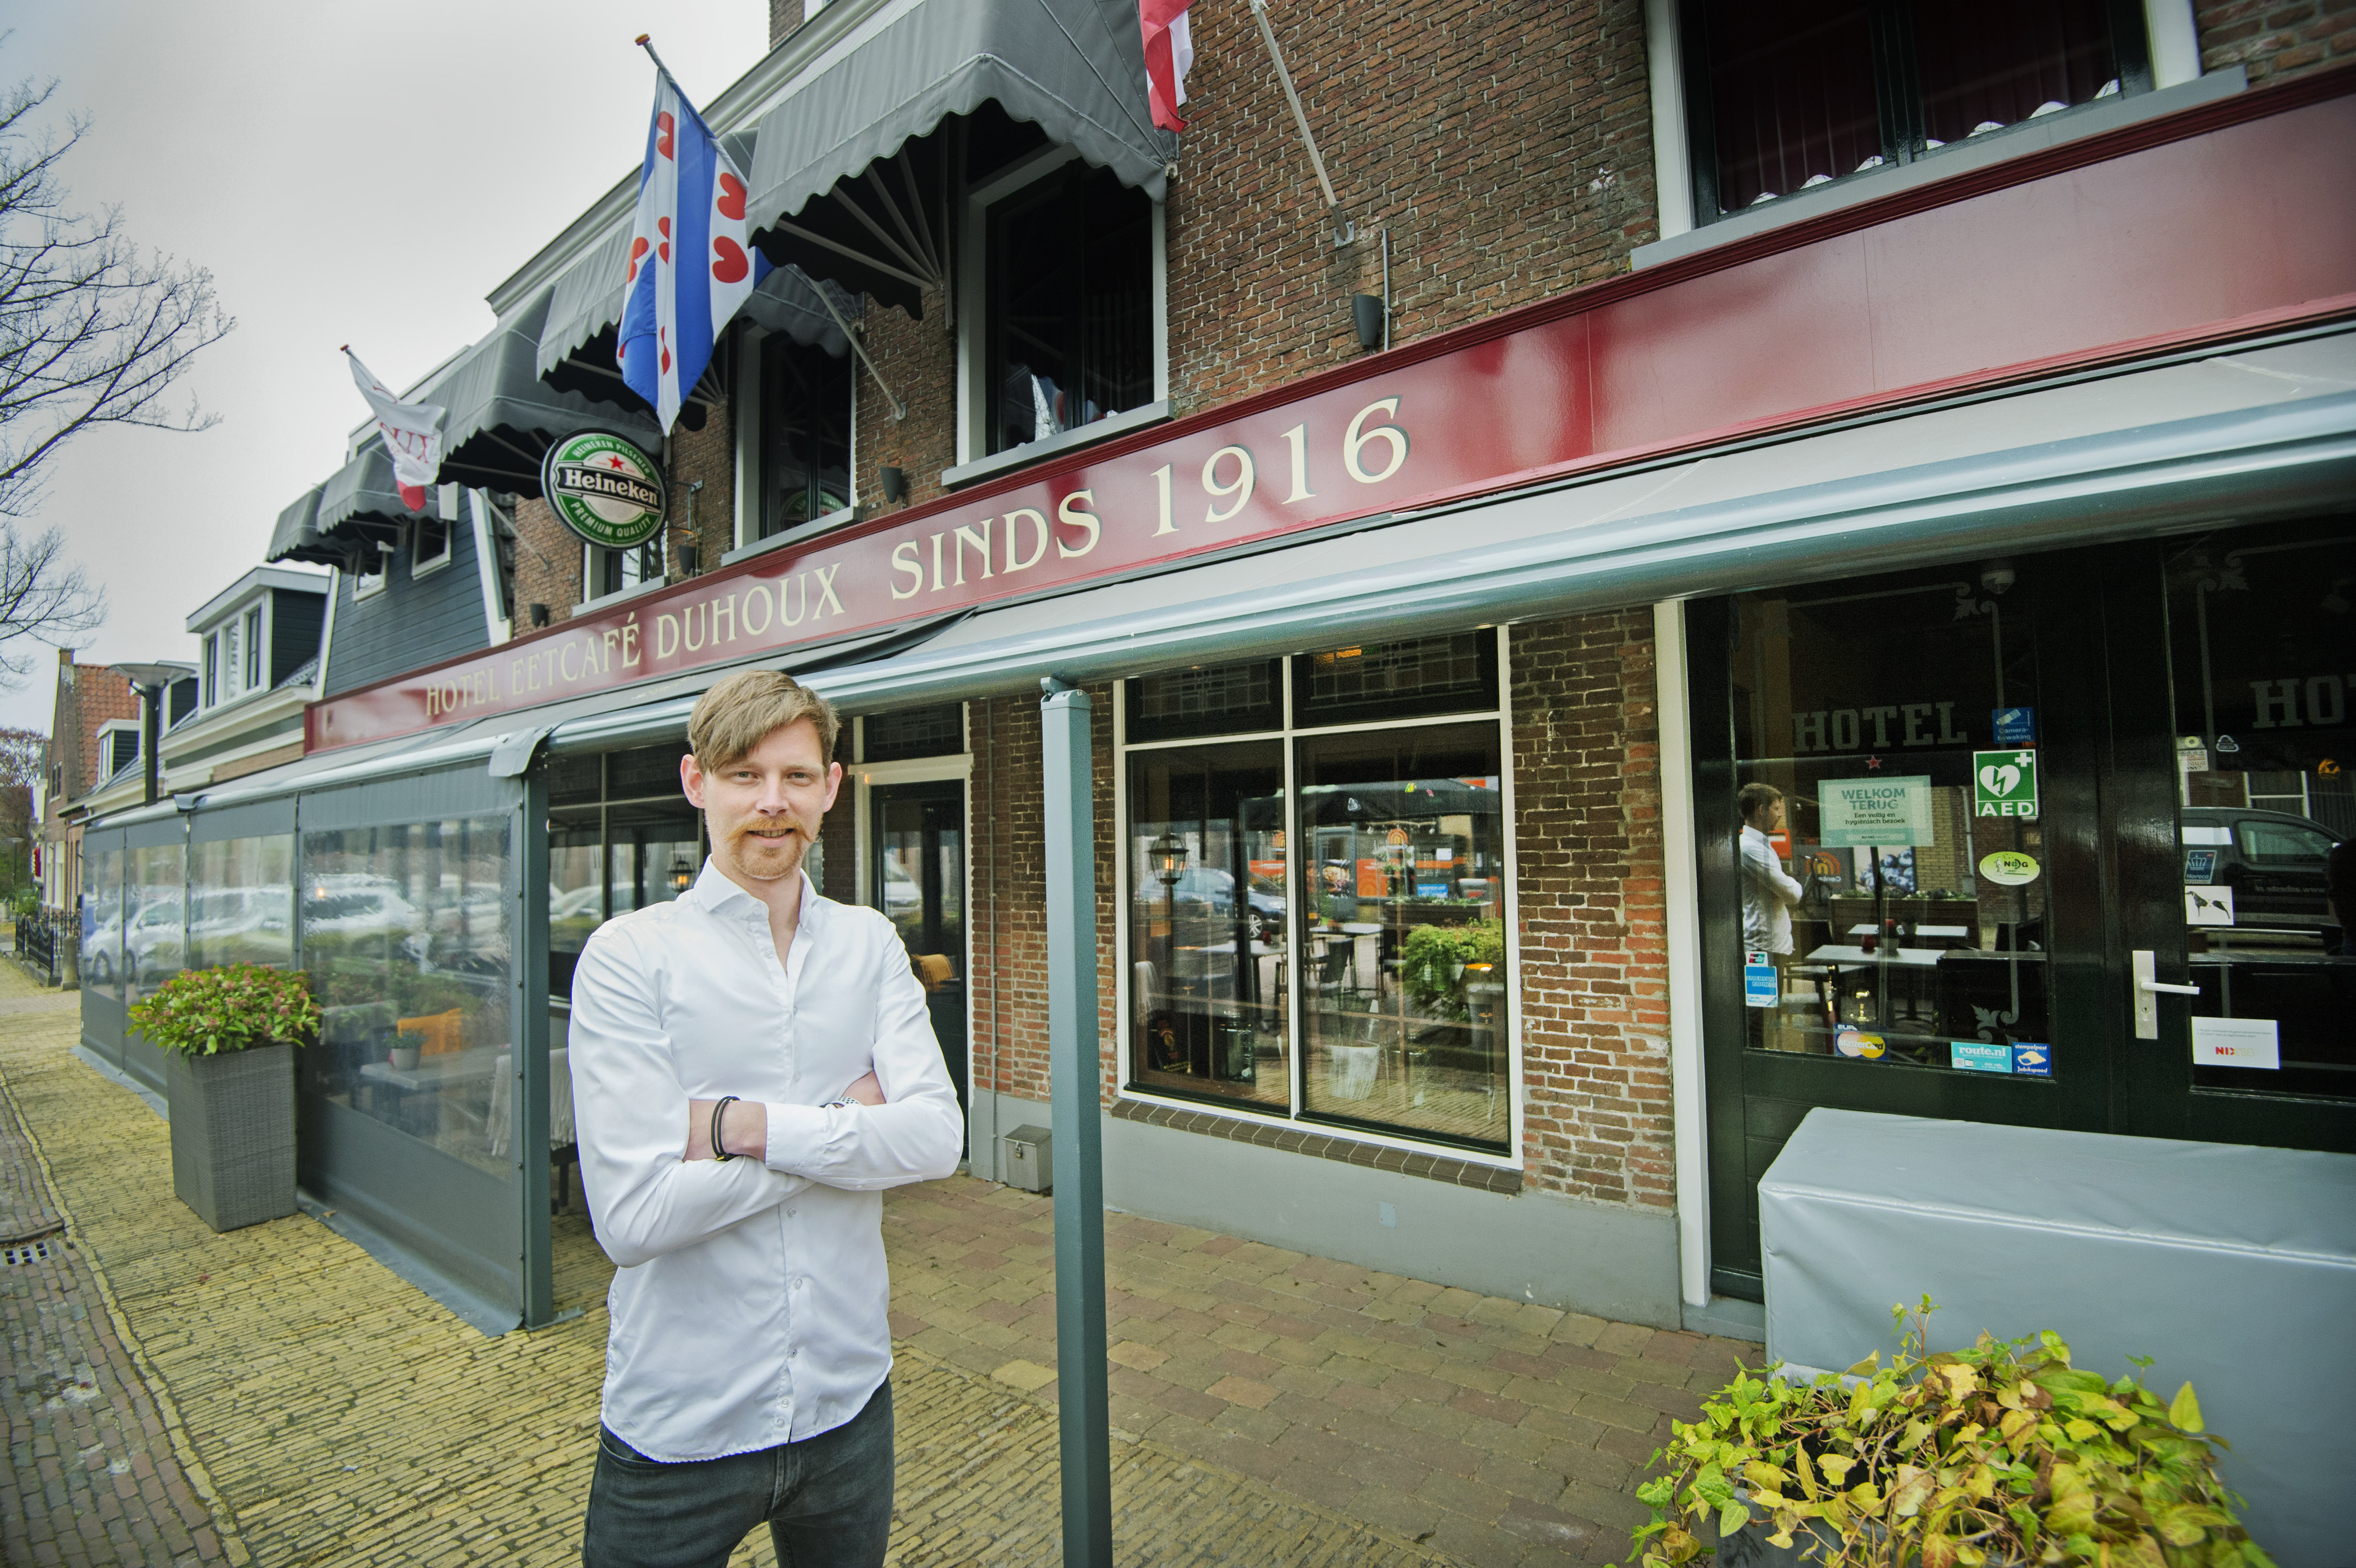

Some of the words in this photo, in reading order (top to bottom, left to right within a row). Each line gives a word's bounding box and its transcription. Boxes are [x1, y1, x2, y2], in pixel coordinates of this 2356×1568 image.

[572, 440, 614, 457] HEINEKEN
[616, 443, 650, 474] PILSENER
[564, 468, 658, 506] Heineken
[570, 501, 612, 535] PREMIUM
[617, 516, 651, 537] QUALITY
[426, 666, 500, 716] HOTEL
[512, 611, 641, 695] EETCAFÉ
[656, 562, 845, 660] DUHOUX
[890, 487, 1102, 600] SINDS
[1150, 394, 1410, 537] 1916
[2249, 673, 2356, 729] HO
[1792, 701, 1968, 753] HOTEL
[1841, 788, 1906, 800] WELKOM
[1849, 799, 1898, 810] TERUG
[1980, 802, 2034, 816] AED
[1839, 1040, 1883, 1050] MasterCard
[1959, 1046, 2006, 1057] route.nl
